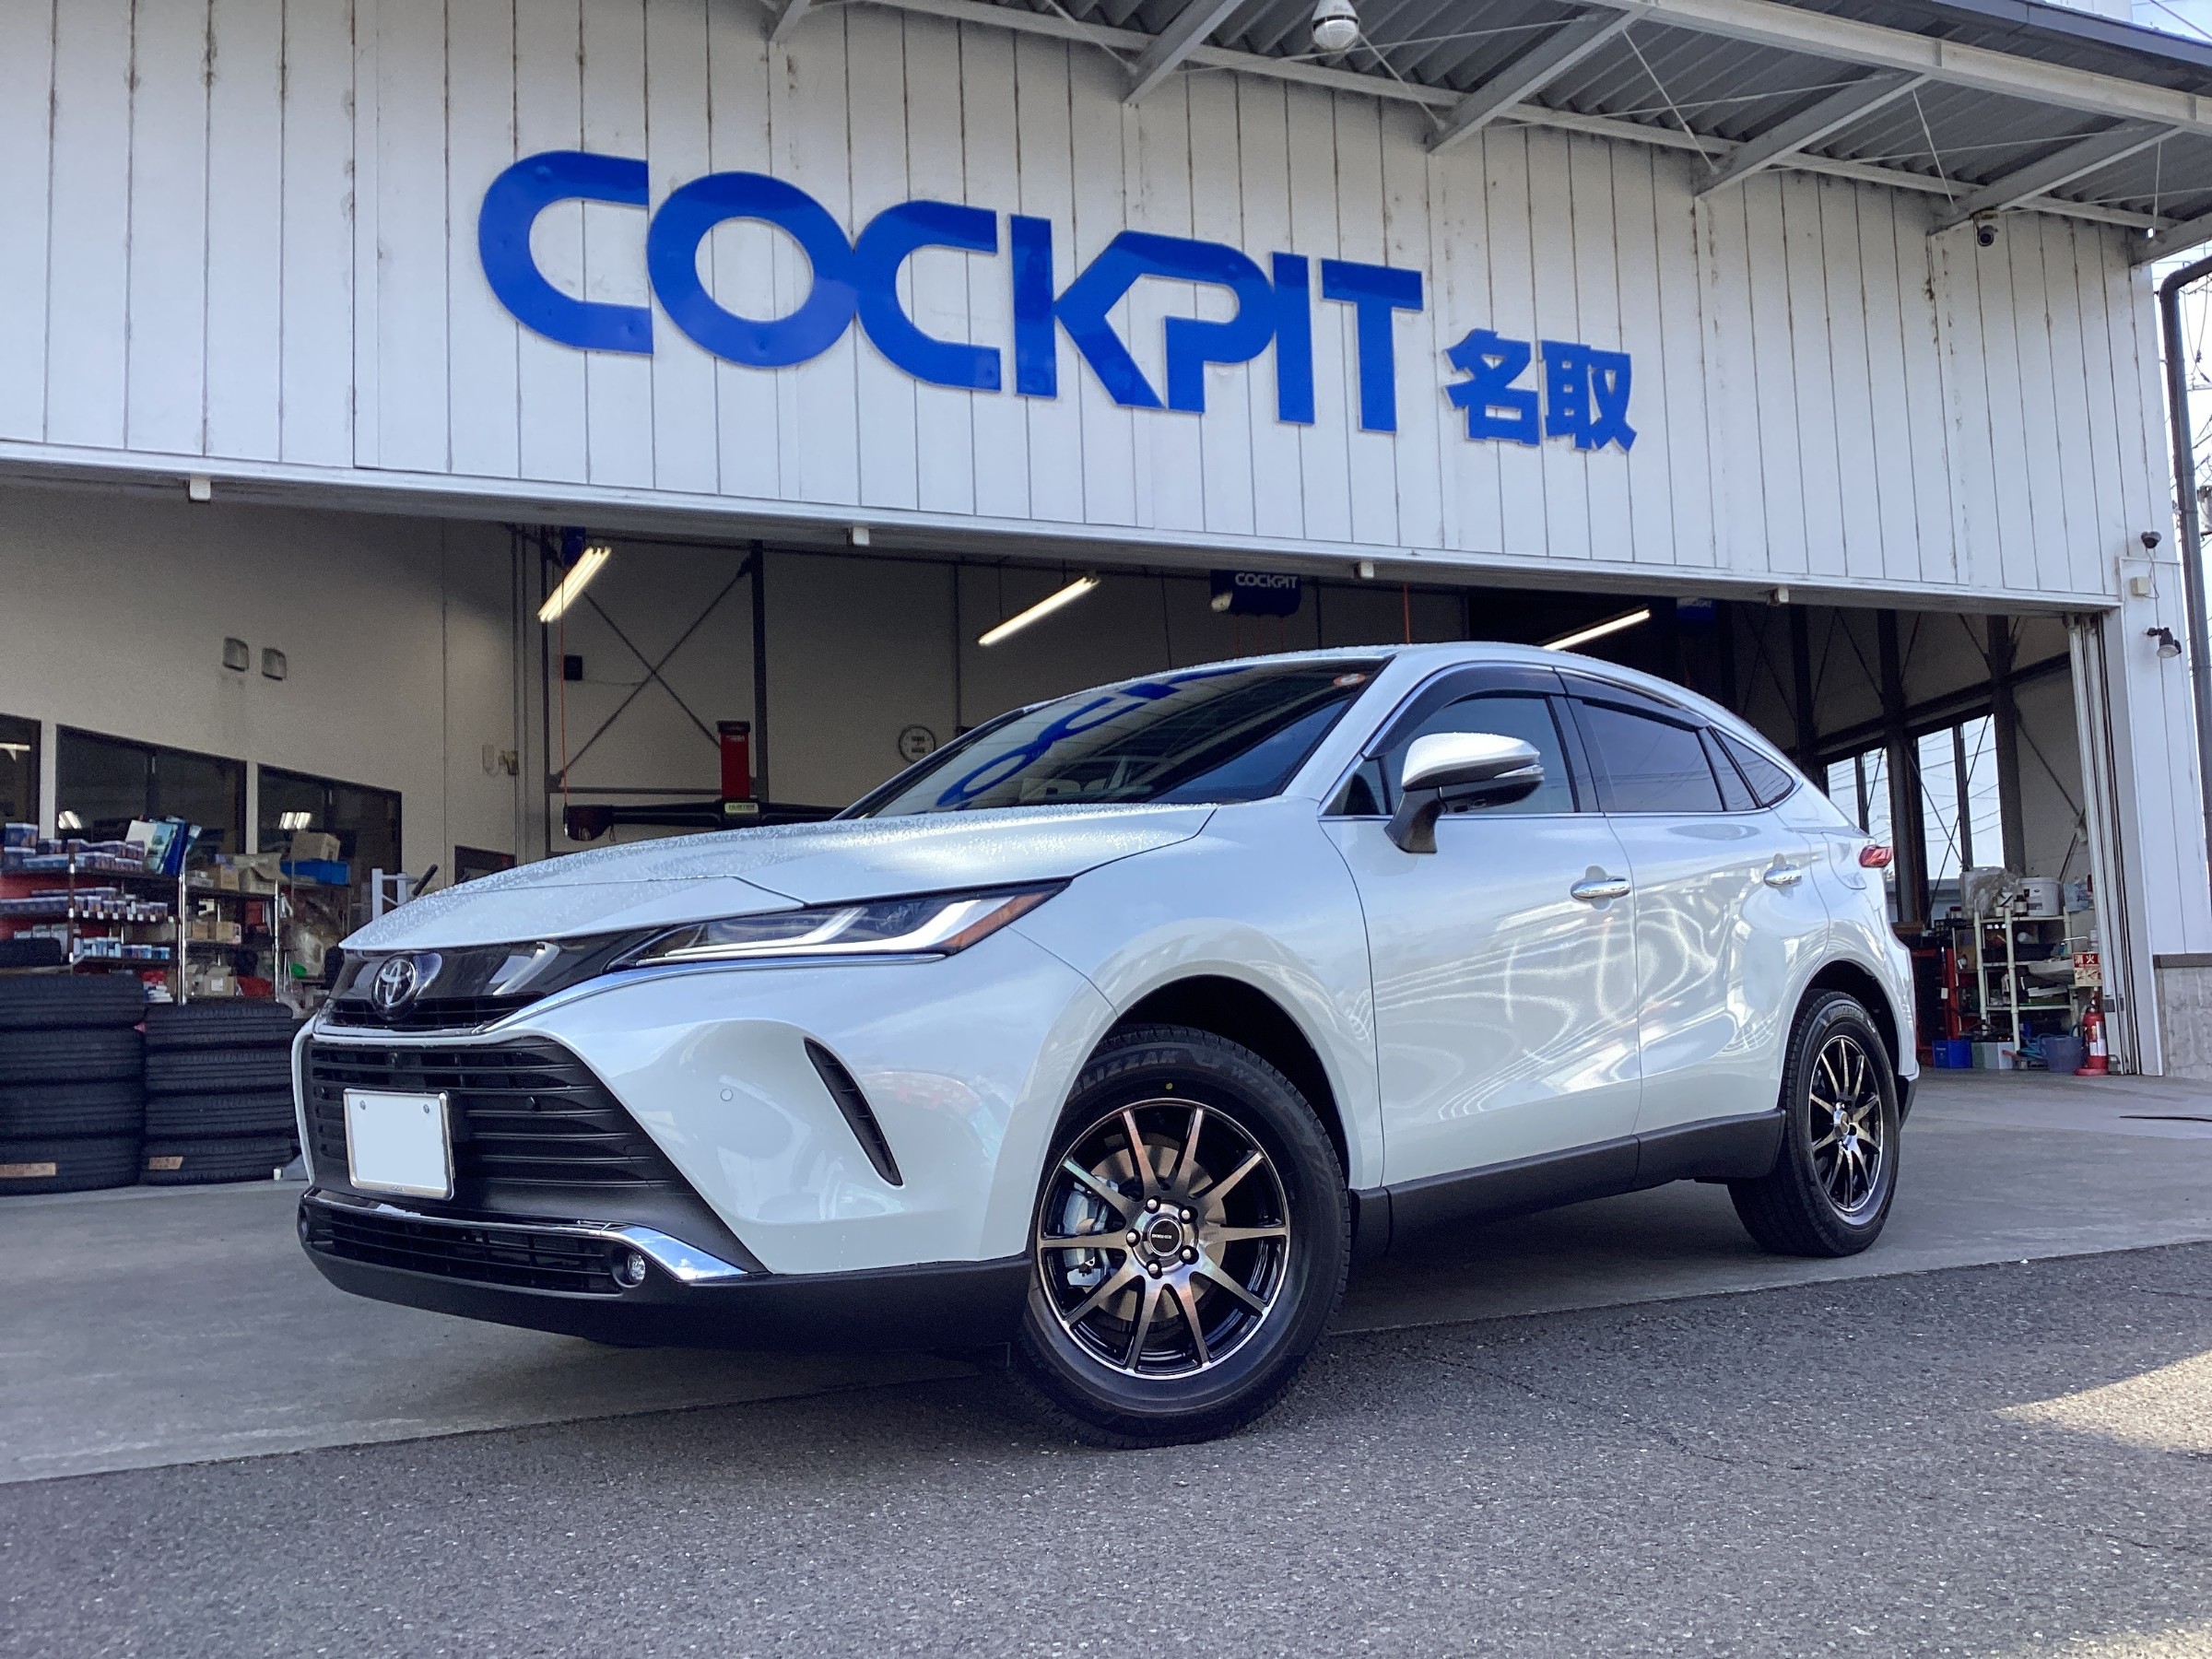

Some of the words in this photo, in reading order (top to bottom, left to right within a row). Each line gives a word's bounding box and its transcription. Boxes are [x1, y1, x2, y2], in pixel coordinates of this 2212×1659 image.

[478, 150, 1423, 433] COCKPIT
[1443, 328, 1637, 453] 名取
[1235, 572, 1298, 588] COCKPIT
[2074, 954, 2100, 964] 消火
